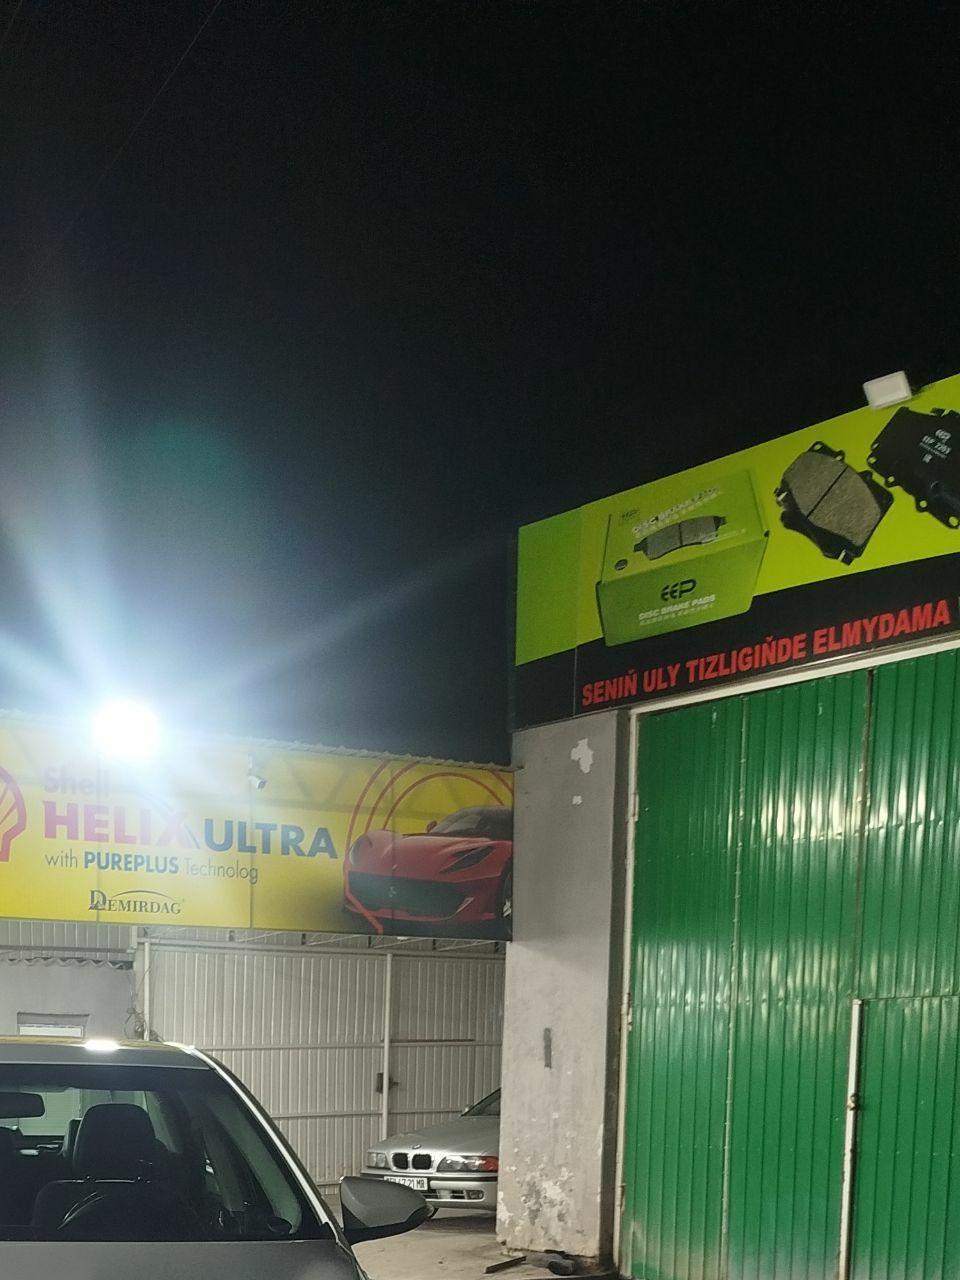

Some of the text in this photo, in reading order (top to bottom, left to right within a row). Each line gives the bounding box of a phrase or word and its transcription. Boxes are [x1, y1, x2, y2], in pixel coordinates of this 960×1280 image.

[643, 666, 681, 693] ULY
[813, 599, 951, 655] ELMYDAMA
[44, 765, 110, 798] Shell
[42, 800, 339, 860] HELIX ULTRA
[45, 848, 259, 885] with PUREPLUS Technolog
[88, 889, 182, 914] DEMIRDAG
